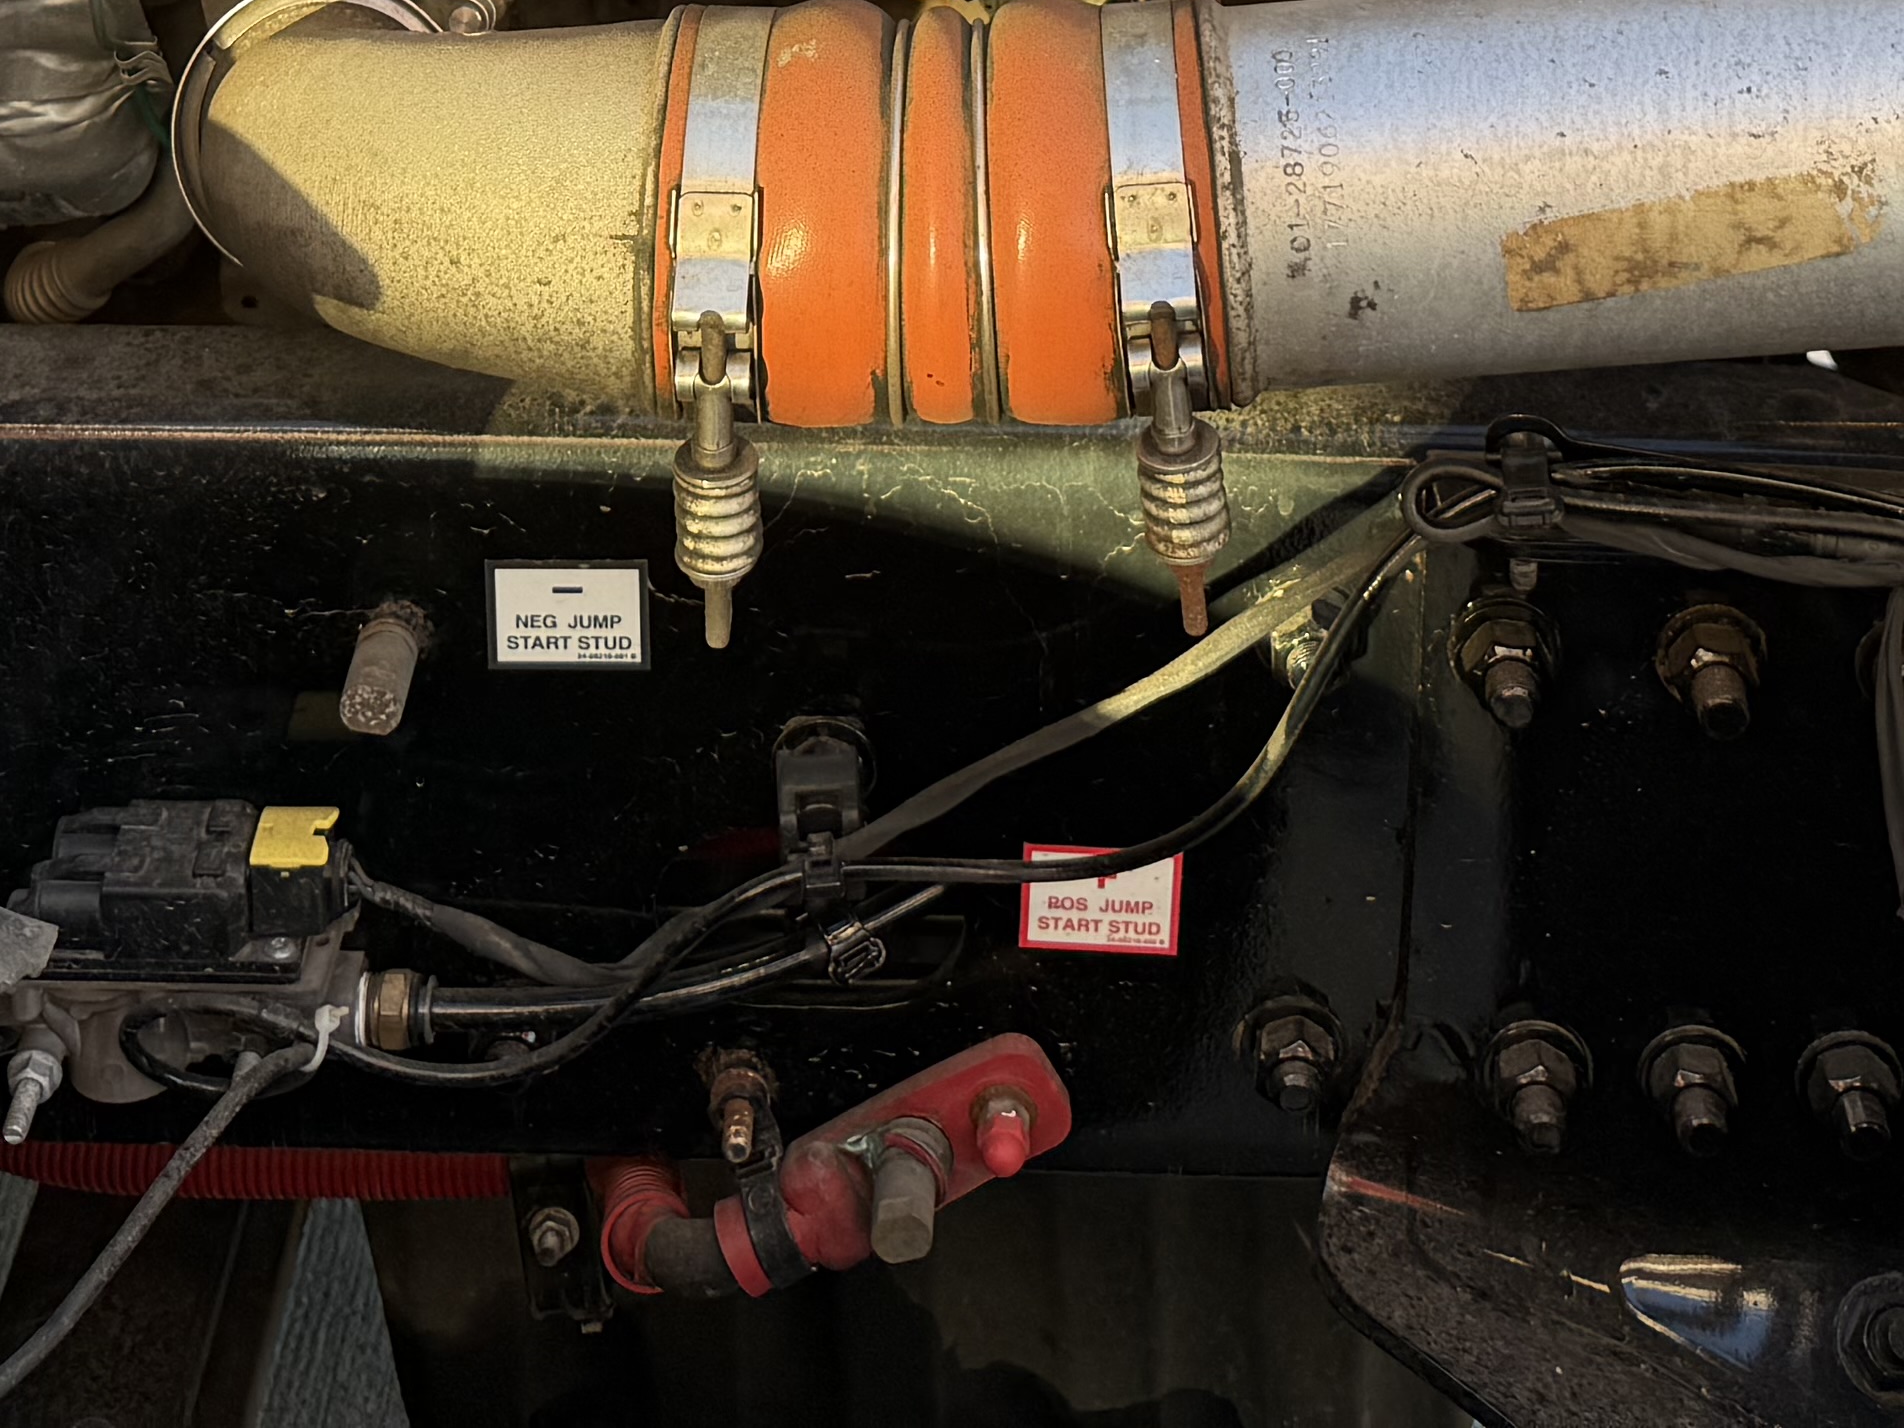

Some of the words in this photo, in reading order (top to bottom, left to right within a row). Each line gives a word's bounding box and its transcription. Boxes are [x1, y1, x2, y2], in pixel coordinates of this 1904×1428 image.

[515, 614, 557, 629] NEG
[567, 614, 622, 630] JUMP
[507, 635, 571, 650] START
[578, 635, 632, 650] STUD
[1048, 895, 1088, 912] POS
[1099, 898, 1154, 916] JUMP
[1037, 916, 1103, 933] START
[1108, 920, 1161, 936] STUD
